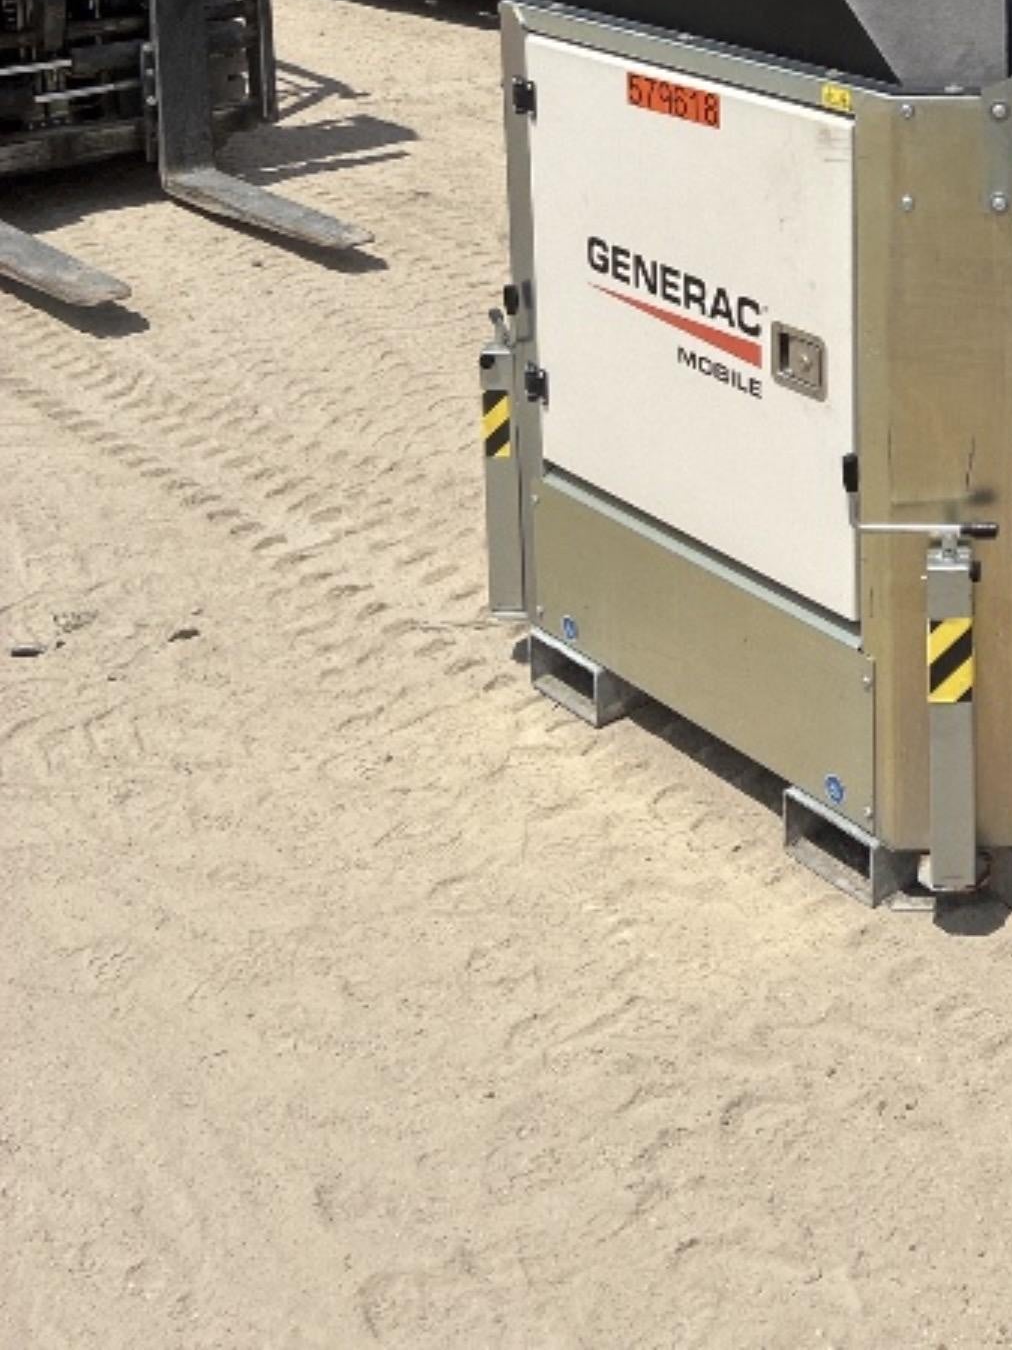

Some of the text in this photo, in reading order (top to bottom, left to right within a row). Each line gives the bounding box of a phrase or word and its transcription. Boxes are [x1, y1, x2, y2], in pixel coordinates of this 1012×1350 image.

[628, 75, 720, 127] 579618
[587, 236, 762, 336] GENERAC
[677, 347, 762, 399] MOBILE
